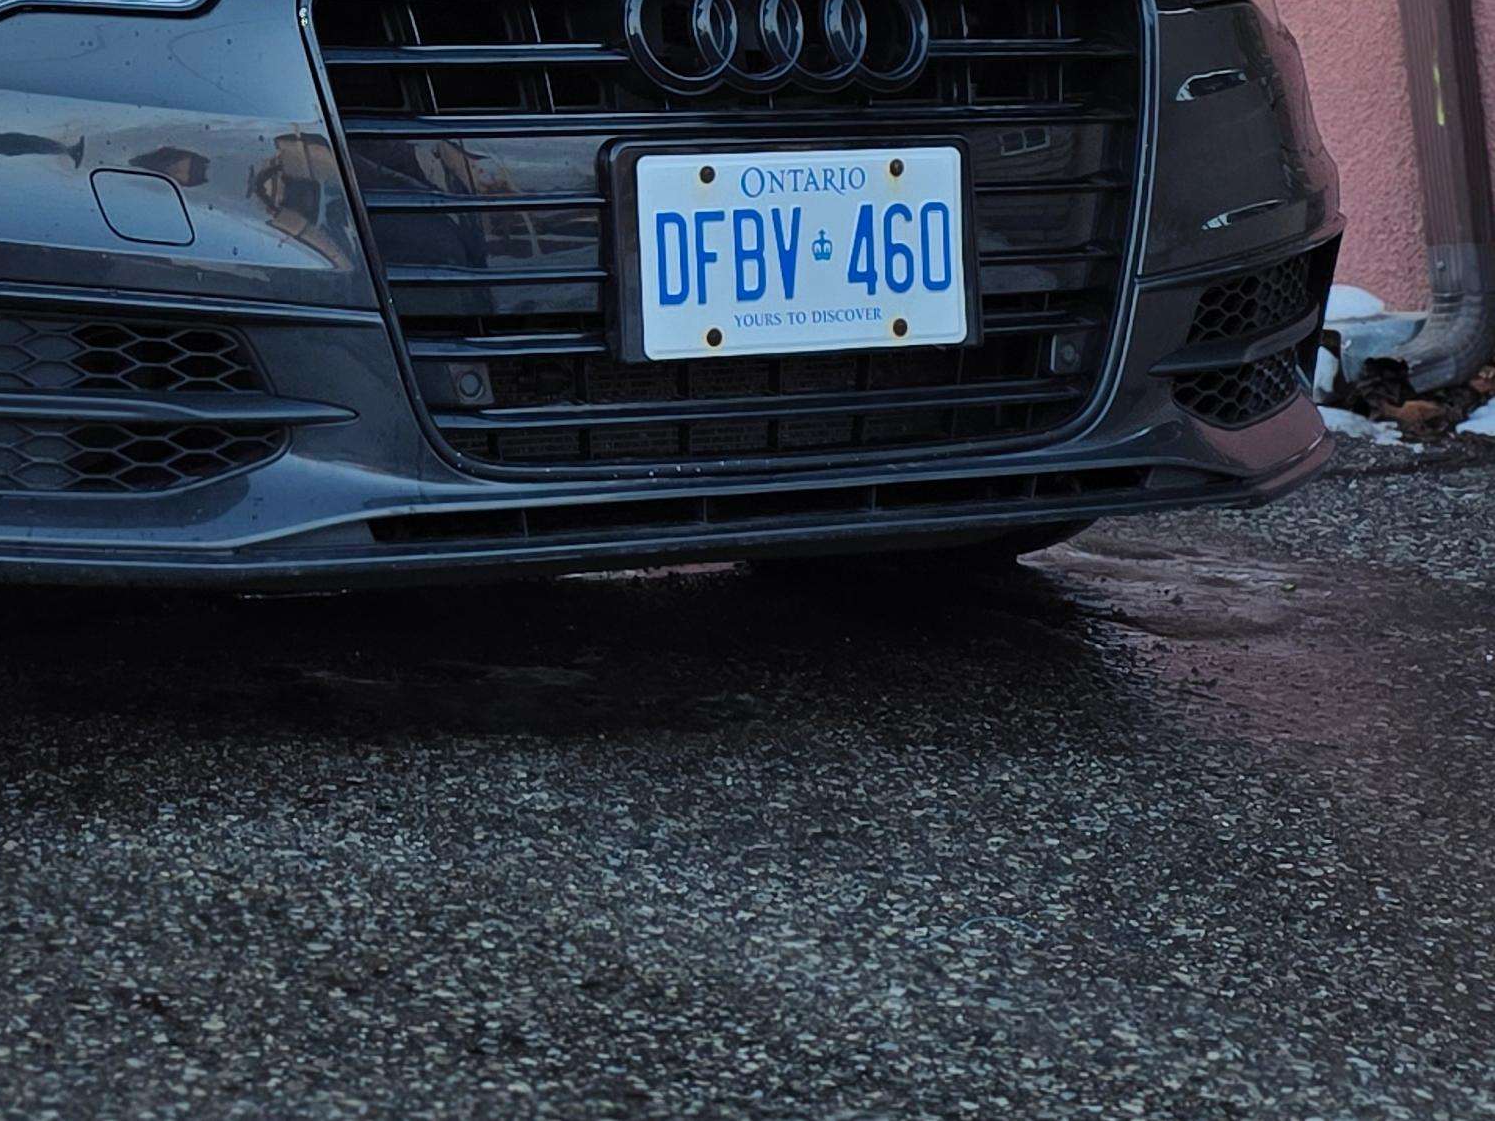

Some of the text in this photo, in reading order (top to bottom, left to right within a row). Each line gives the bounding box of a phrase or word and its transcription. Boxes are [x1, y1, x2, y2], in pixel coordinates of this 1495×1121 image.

[740, 166, 866, 198] ONTARIO
[655, 201, 953, 306] DFBV 460
[733, 306, 883, 328] YOURS TO DISCOVER
